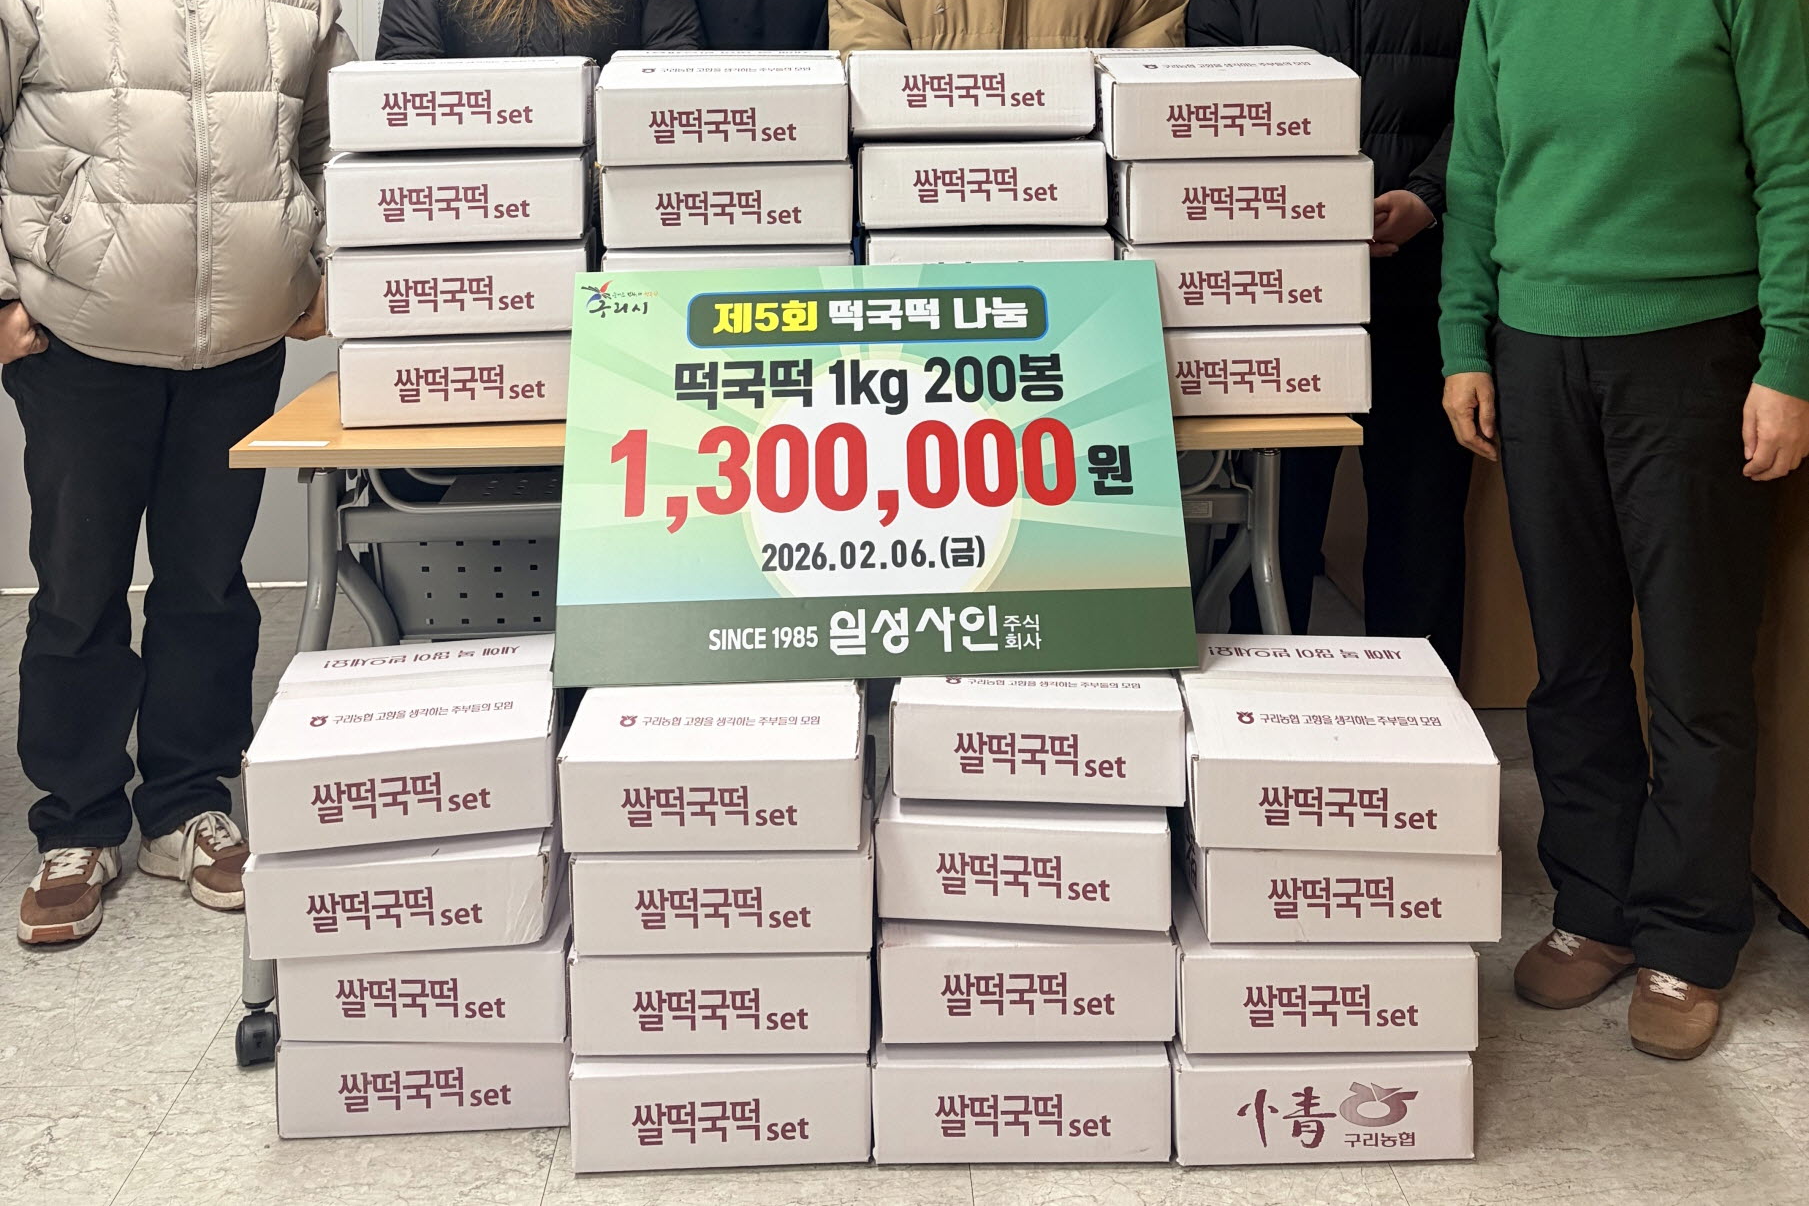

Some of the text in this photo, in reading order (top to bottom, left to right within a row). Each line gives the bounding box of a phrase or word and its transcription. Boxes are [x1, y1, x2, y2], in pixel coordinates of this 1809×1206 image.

[589, 300, 648, 319] 구리시
[712, 296, 1028, 334] 제5회 떡국떡 나눔
[674, 353, 1064, 415] 떡국떡 1kg 200봉
[611, 418, 1077, 533] 1,300,000
[708, 605, 999, 656] SINCE 1985 일성사인
[332, 700, 514, 725] 구리농협 고향을 생각하는 주부들의 모임
[642, 715, 821, 727] 구리농협 고향을 생각하는 주부들의 모임
[1259, 712, 1442, 727] 구리농협 고향을 생각하는 주부들의 모임
[1344, 1132, 1415, 1147] 구리농협
